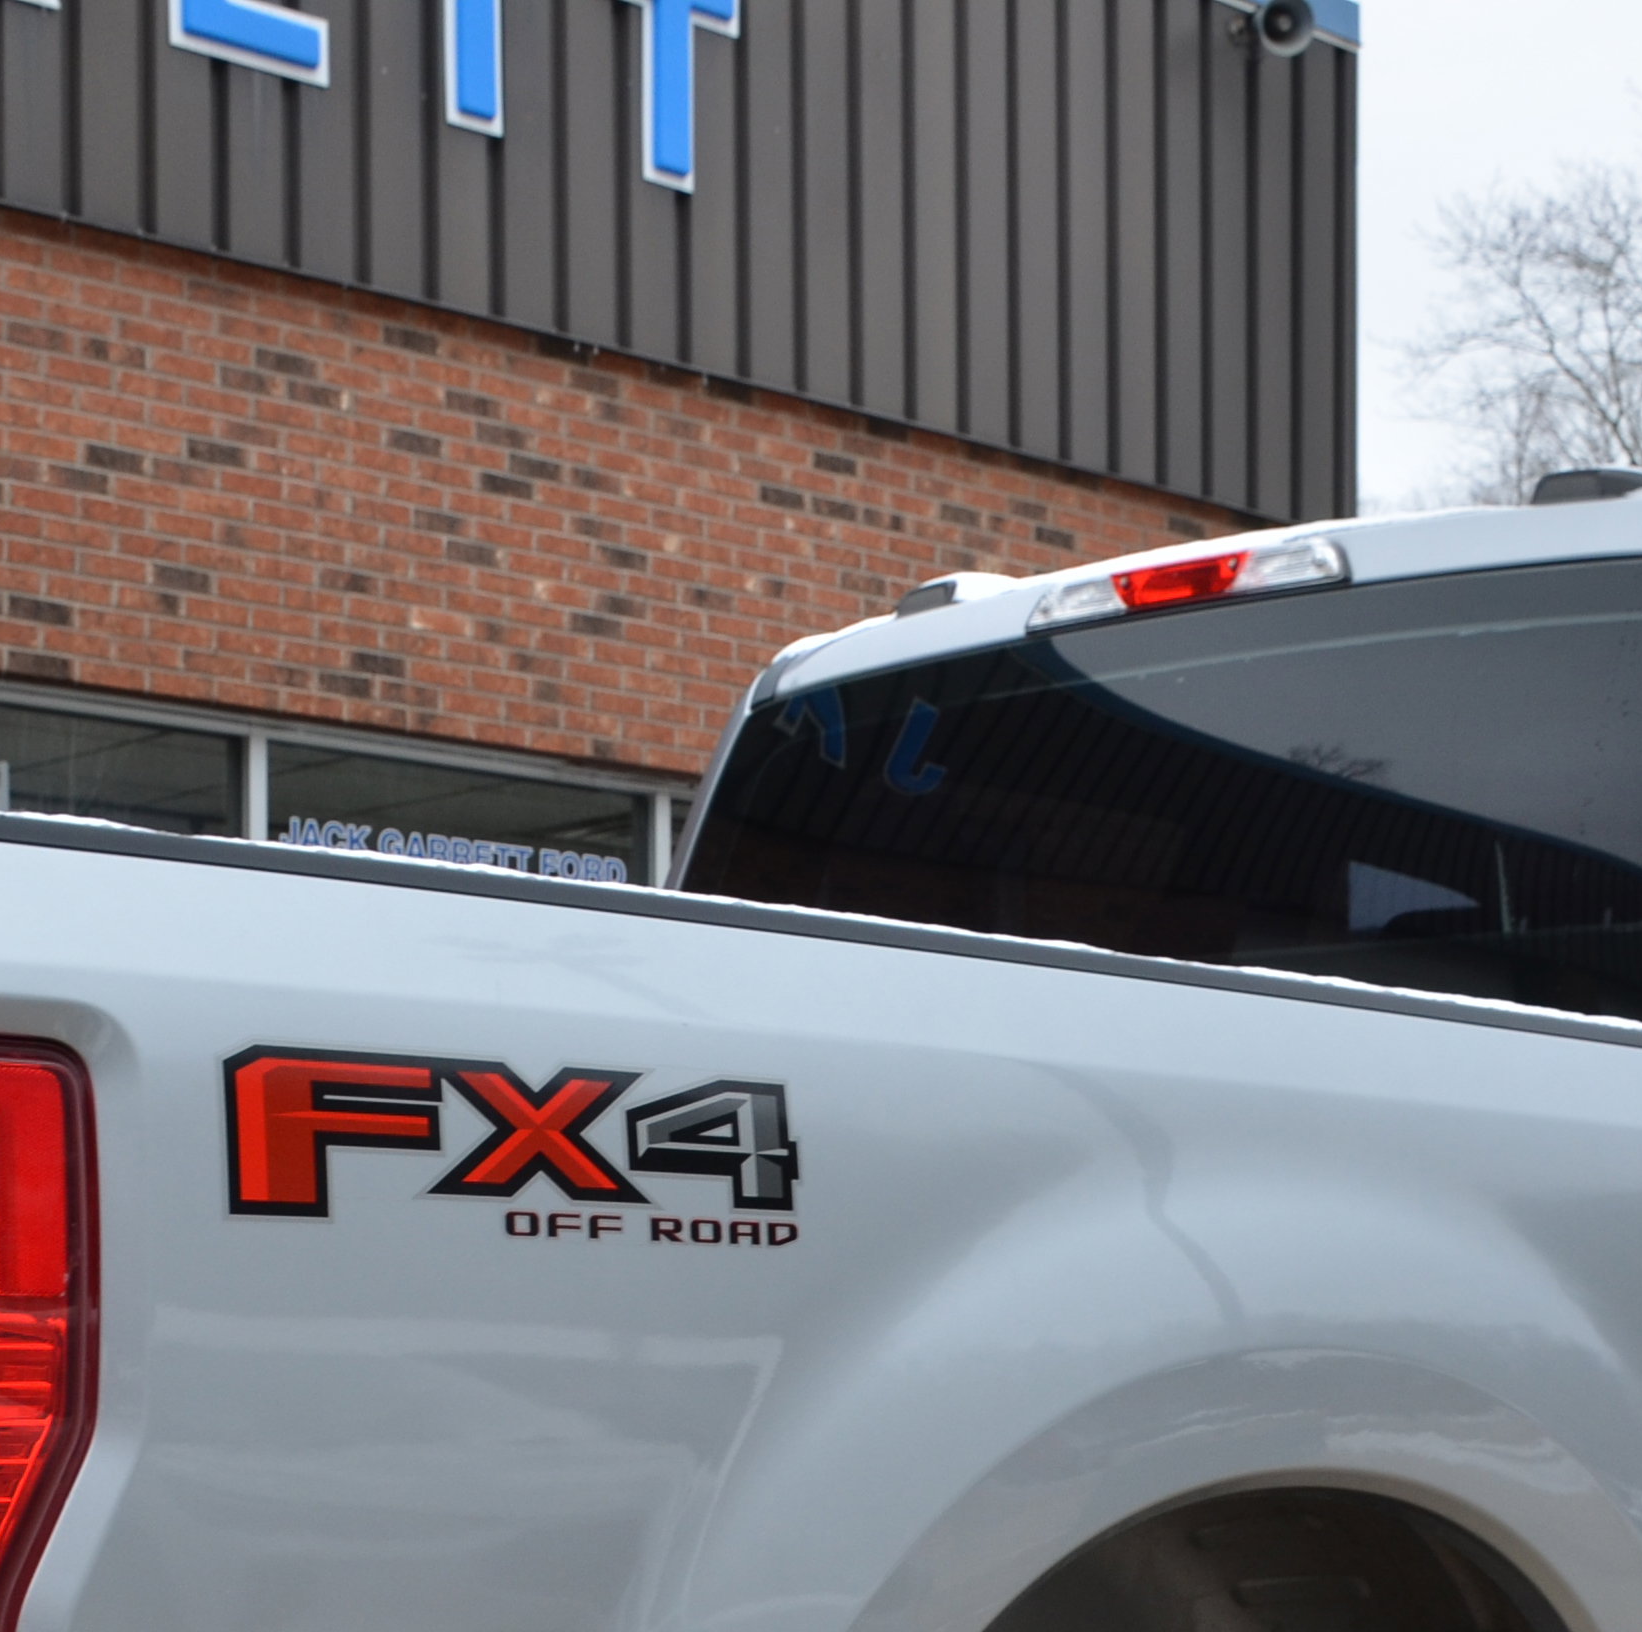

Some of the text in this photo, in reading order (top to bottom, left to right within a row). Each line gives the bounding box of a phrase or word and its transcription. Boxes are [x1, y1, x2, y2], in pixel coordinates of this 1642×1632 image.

[279, 816, 372, 853] JACK
[538, 847, 628, 884] FORD
[222, 1044, 799, 1218] FX4
[505, 1210, 799, 1247] OFF ROAD
